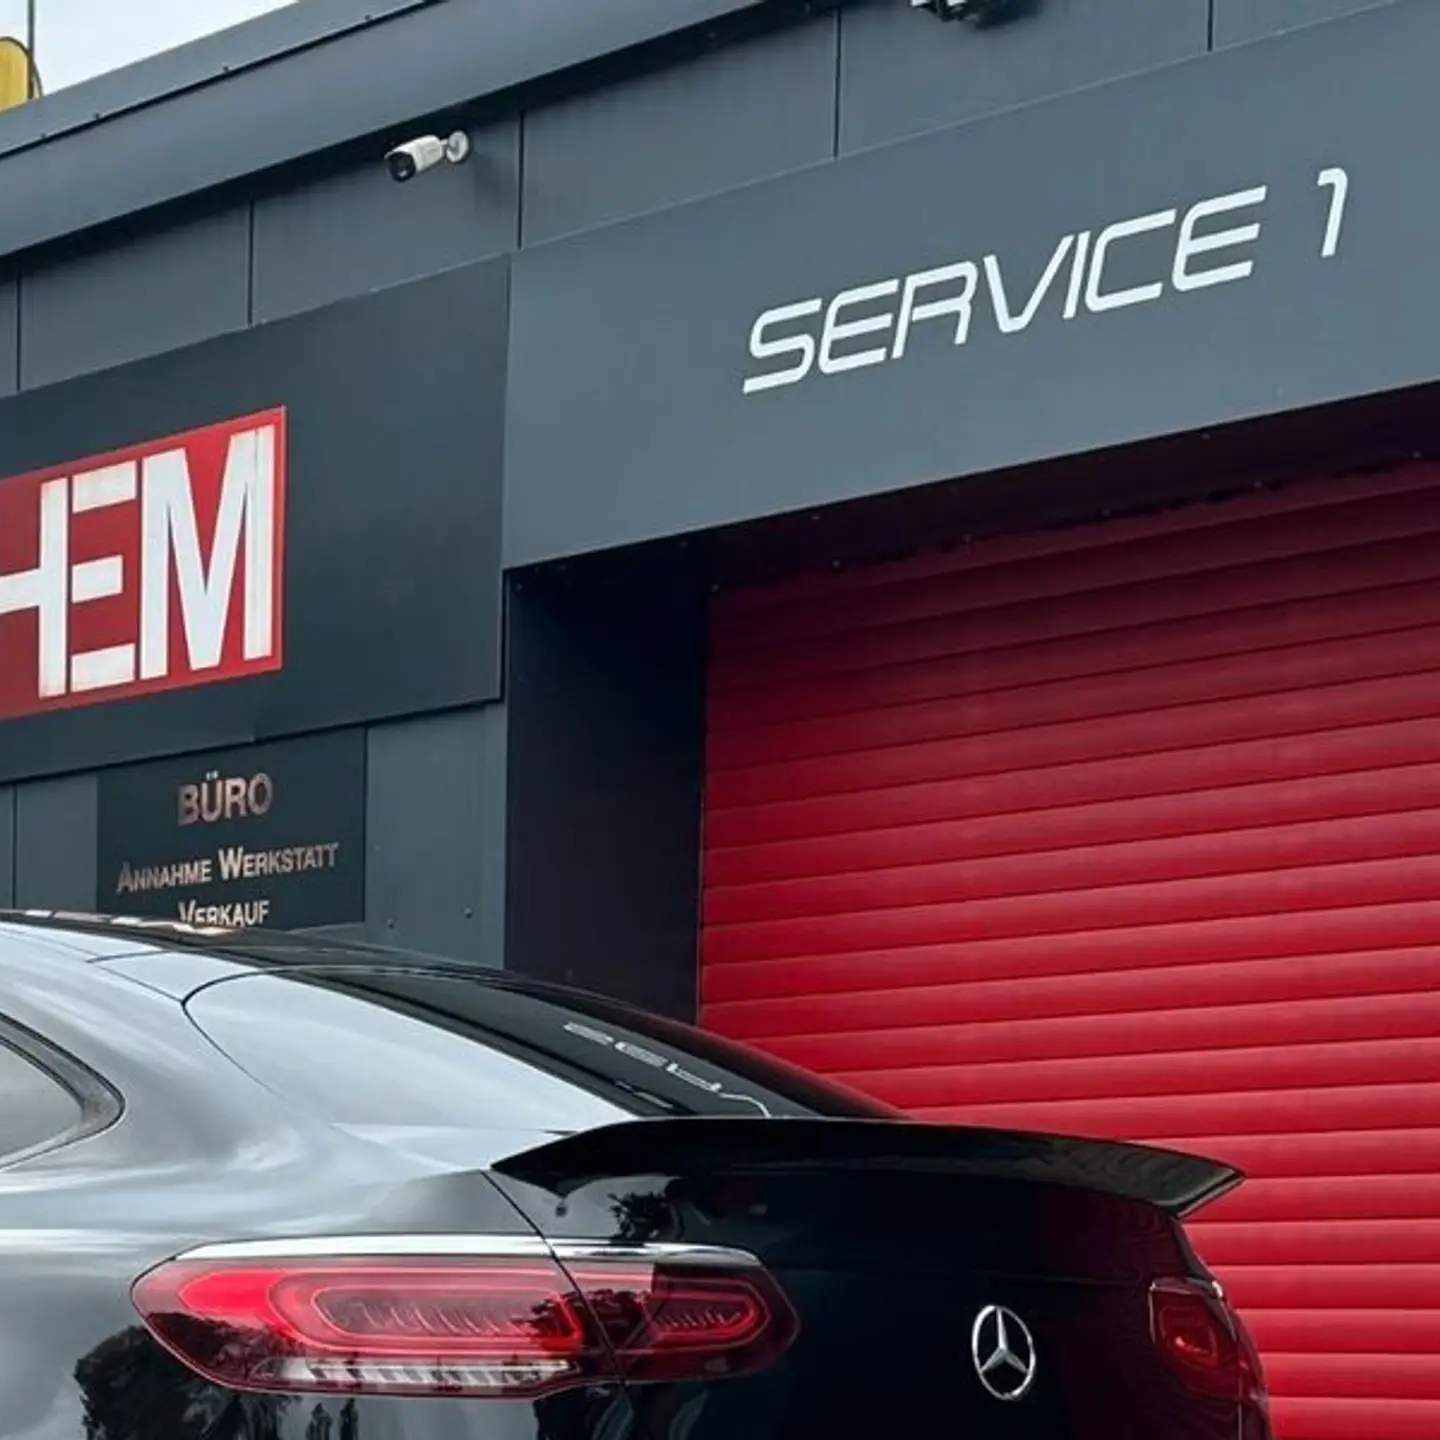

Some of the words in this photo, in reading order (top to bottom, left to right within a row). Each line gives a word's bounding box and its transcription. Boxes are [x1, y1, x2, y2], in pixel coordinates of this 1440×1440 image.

[743, 186, 1266, 393] SERVICE
[1317, 167, 1348, 257] 1
[176, 770, 273, 826] BÜRO
[116, 860, 212, 894] ANNAHME
[218, 843, 339, 881] WERKSTATT
[178, 899, 271, 928] VERKAUF
